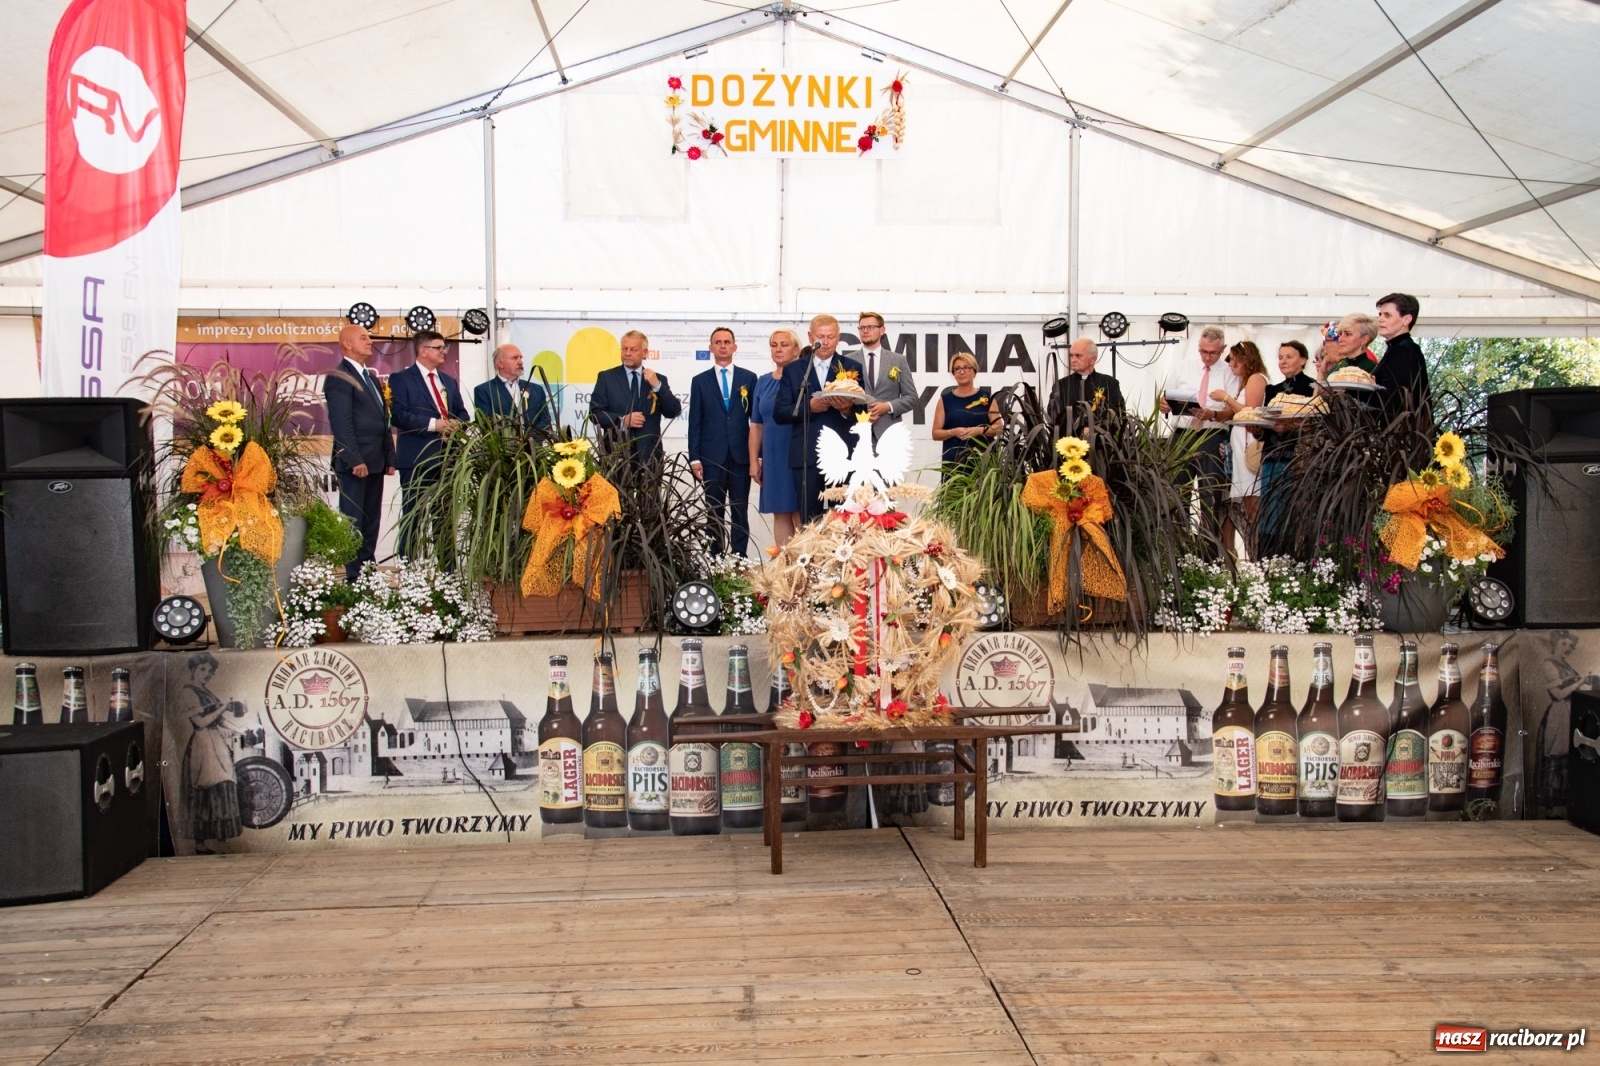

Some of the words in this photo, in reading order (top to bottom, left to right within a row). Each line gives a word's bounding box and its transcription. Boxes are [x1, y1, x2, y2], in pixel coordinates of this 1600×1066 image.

[691, 67, 873, 109] DOŻYNKI
[724, 119, 857, 153] GMINNE
[197, 323, 253, 338] imprezy
[271, 652, 310, 690] BROWAR
[313, 651, 361, 687] ZAMKOWY
[962, 636, 1001, 672] BROWAR
[1003, 635, 1048, 671] ZAMKOWY
[272, 694, 313, 710] A.D.
[319, 687, 361, 714] 1567
[963, 675, 1002, 691] A.D.
[1007, 671, 1047, 698] 1567
[563, 748, 578, 802] LAGER
[1236, 737, 1251, 790] LAGER
[1012, 800, 1073, 818] PIWO
[1080, 800, 1207, 818] TWORZYMY
[287, 822, 323, 842] MY
[328, 818, 394, 840] PIWO
[401, 814, 532, 836] TWORZYMY
